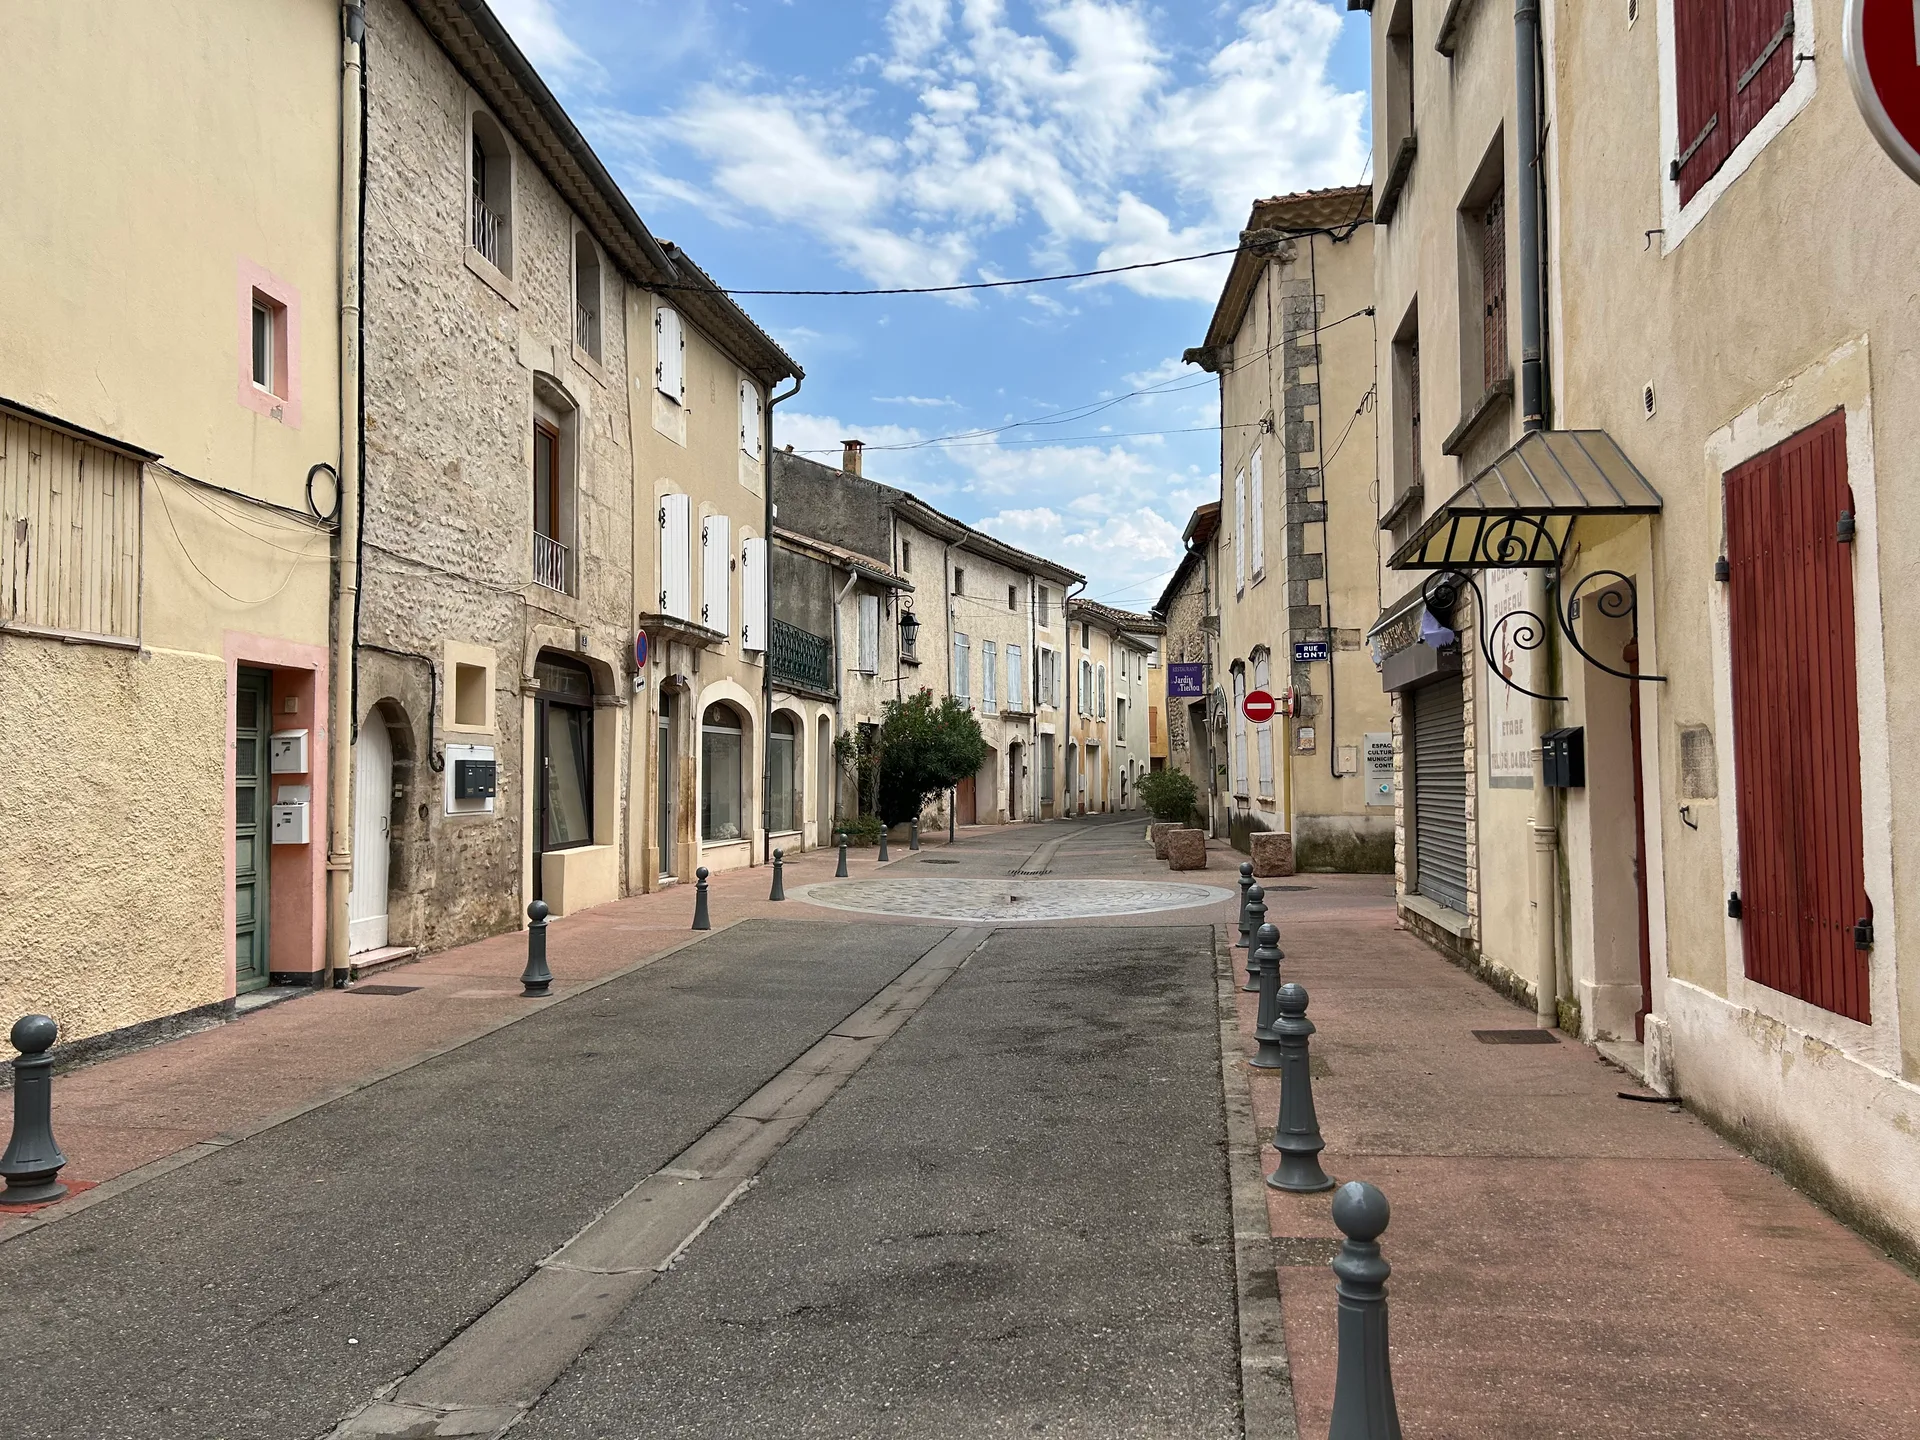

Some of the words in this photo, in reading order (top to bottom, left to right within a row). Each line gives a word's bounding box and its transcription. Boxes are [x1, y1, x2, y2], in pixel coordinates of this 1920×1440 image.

[1494, 590, 1522, 619] BUREAU
[1295, 651, 1327, 659] CONTI
[1501, 718, 1524, 737] ETAGE
